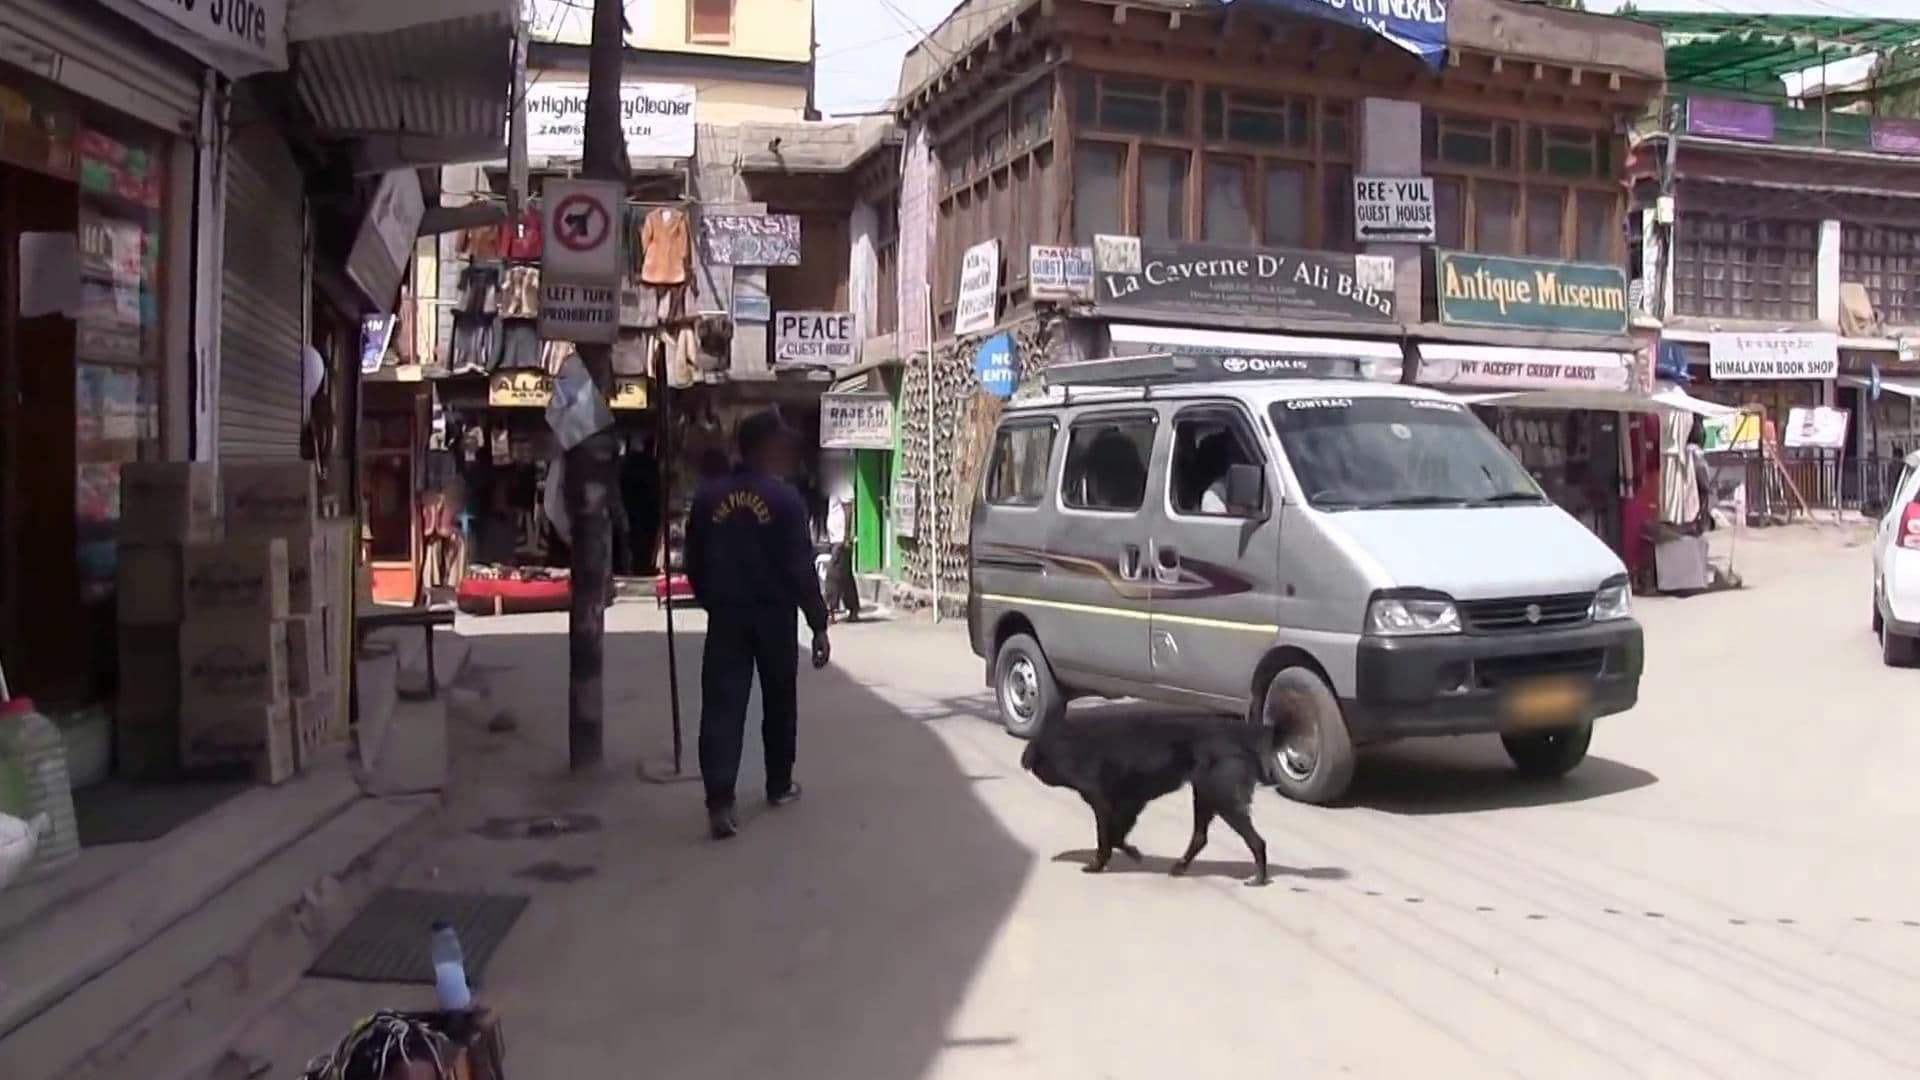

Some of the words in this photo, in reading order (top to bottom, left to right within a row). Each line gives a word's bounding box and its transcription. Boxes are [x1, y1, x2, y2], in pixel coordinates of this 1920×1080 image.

[1357, 181, 1430, 202] REE-YUL
[1396, 205, 1432, 223] HOUSE
[546, 287, 575, 301] LEFT
[583, 287, 613, 303] TURN
[1105, 274, 1141, 299] La
[1144, 259, 1250, 285] Caverne
[1293, 261, 1329, 290] Ali
[1337, 273, 1392, 317] Baba
[1446, 261, 1533, 315] Antique
[1534, 270, 1625, 313] Museum
[542, 307, 613, 323] PROHIBITED
[783, 316, 849, 340] PEACE
[1460, 360, 1478, 374] WE
[1482, 361, 1524, 377] ACCEPT
[1715, 361, 1774, 375] HIMALAYAN
[1776, 361, 1805, 374] BOOK
[1807, 361, 1835, 374] SHOP
[829, 406, 886, 420] RAJESH
